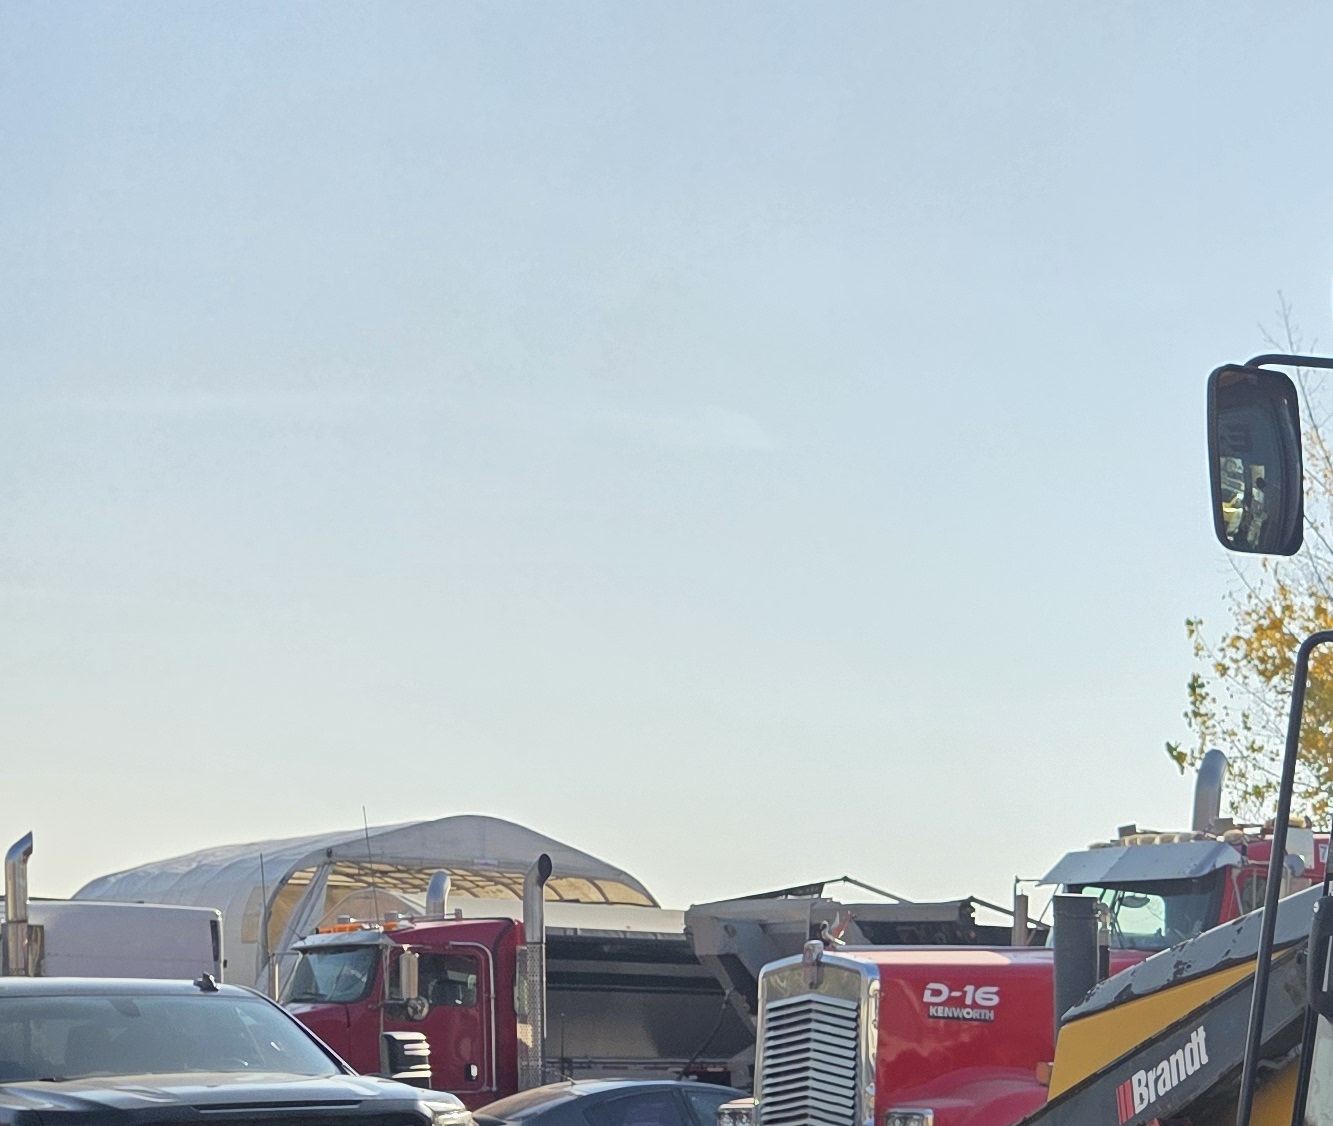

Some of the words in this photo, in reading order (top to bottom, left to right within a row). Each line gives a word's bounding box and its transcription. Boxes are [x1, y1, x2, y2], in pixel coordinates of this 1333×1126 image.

[922, 982, 1000, 1007] D-16
[929, 1005, 995, 1020] KENWORTH
[1131, 1025, 1209, 1115] Brandt
